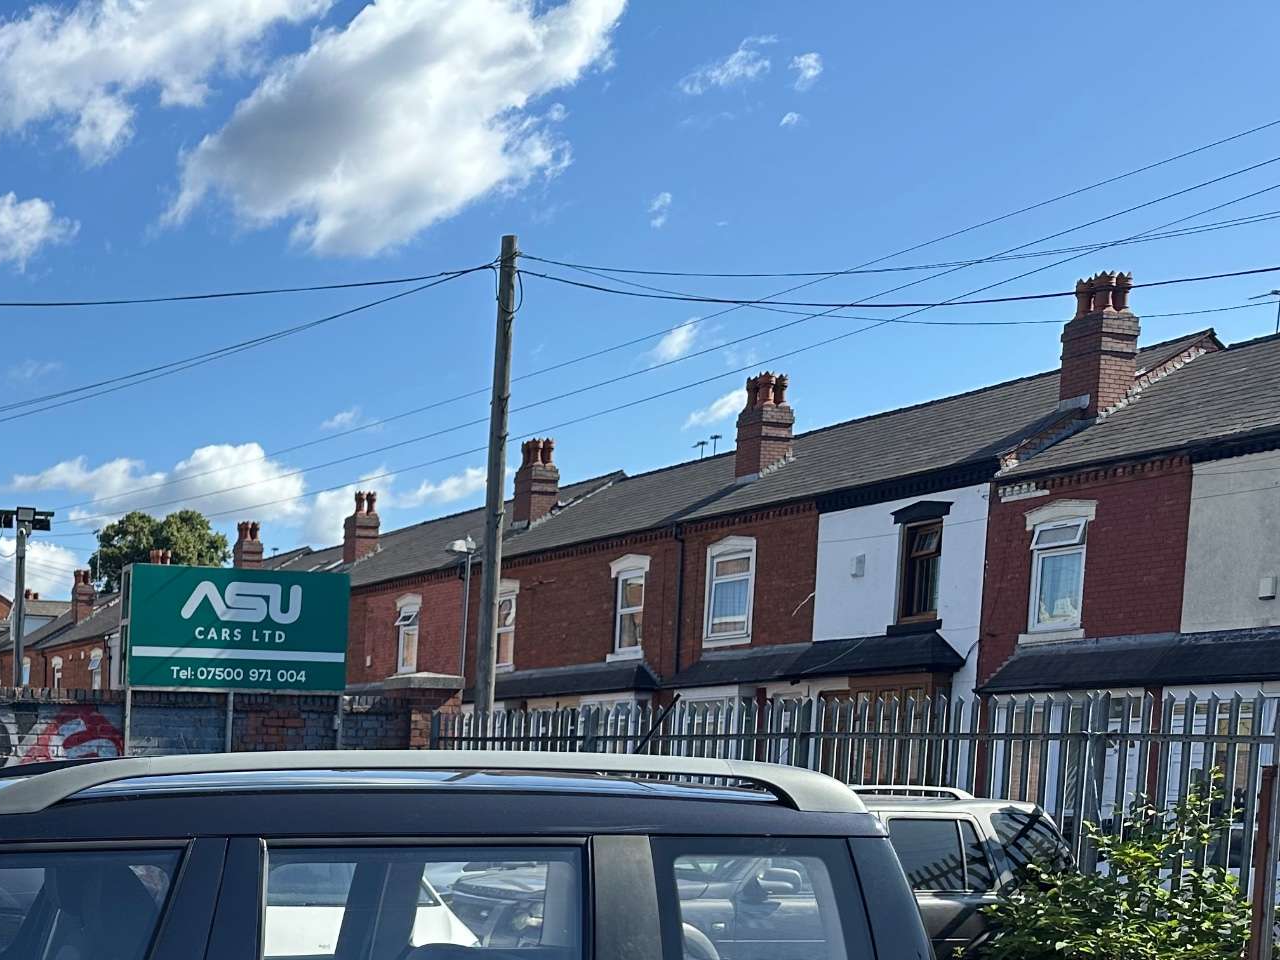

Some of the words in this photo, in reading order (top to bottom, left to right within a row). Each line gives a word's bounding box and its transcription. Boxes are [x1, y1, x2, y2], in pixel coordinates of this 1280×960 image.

[181, 581, 302, 624] ASU
[194, 626, 242, 642] CARS
[251, 630, 286, 643] LTD
[170, 666, 195, 680] Tel:
[196, 667, 244, 681] 07500
[248, 669, 271, 682] 971
[276, 669, 306, 683] 004
